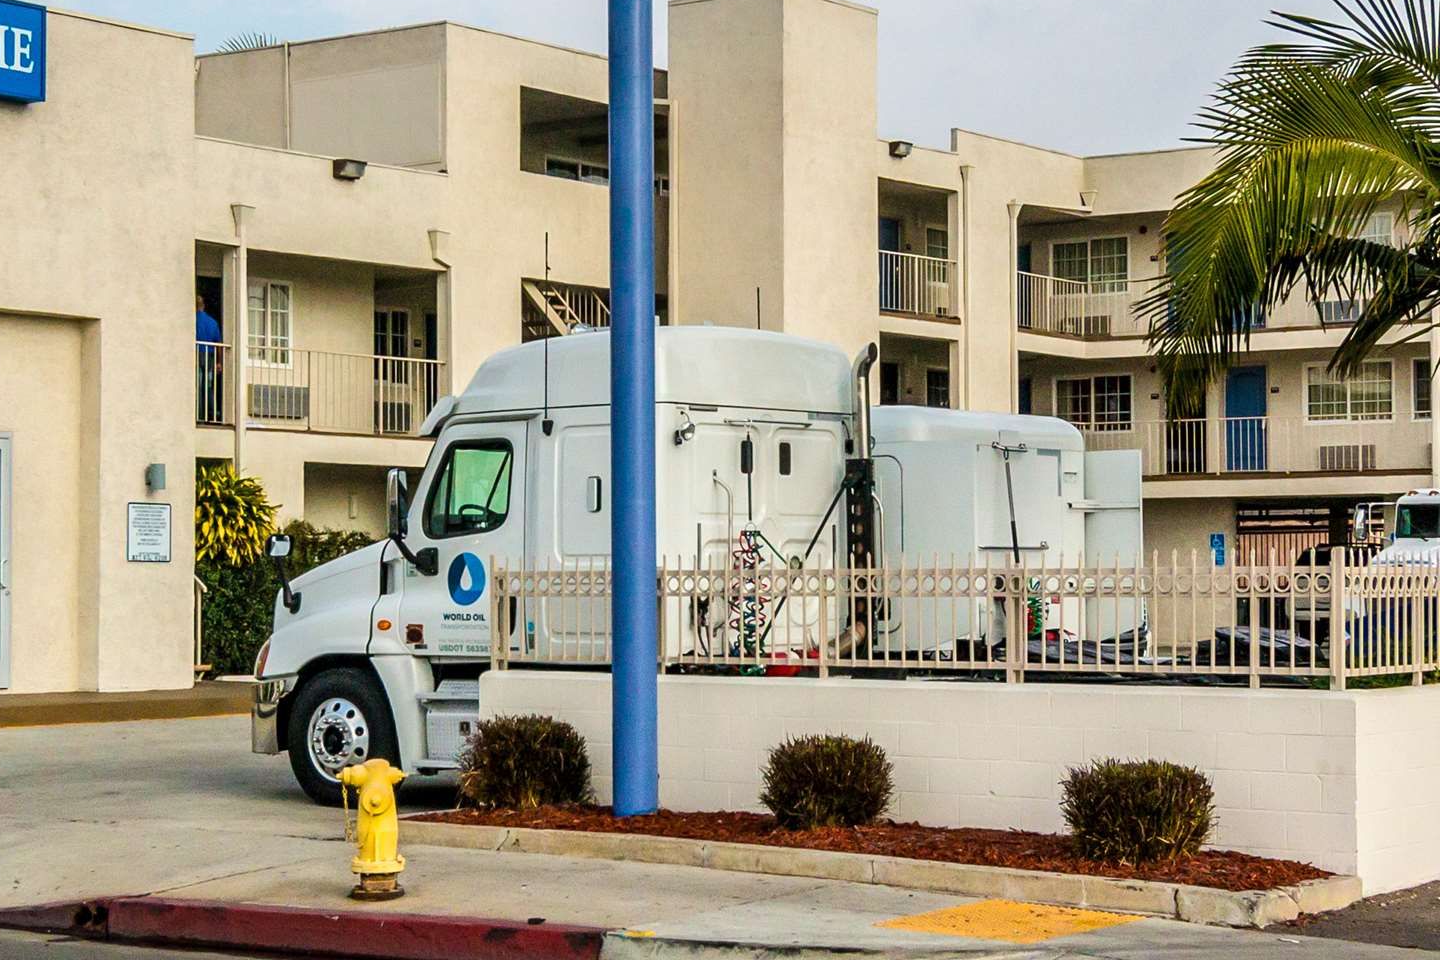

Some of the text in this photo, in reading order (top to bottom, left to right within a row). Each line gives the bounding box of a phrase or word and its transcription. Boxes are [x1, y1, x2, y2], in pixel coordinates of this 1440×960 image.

[443, 613, 486, 622] WORLD OIL
[439, 644, 464, 652] USDOT
